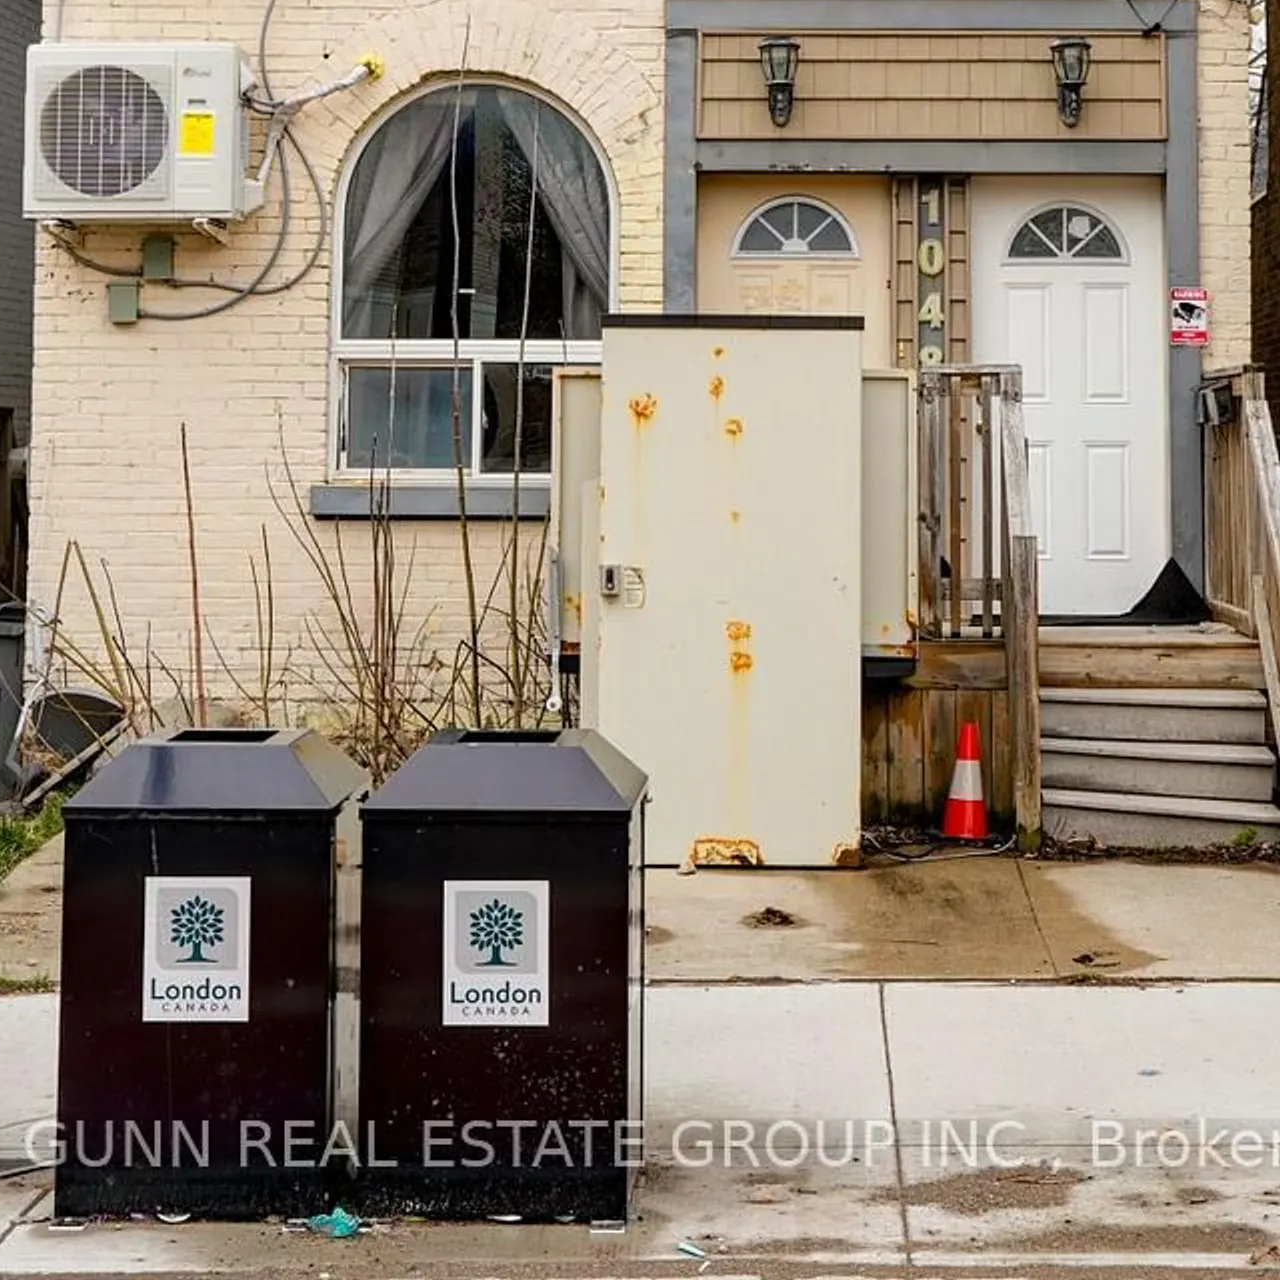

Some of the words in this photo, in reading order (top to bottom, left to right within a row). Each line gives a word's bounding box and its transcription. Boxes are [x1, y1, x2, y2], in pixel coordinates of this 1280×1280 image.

[150, 977, 241, 1000] London
[450, 980, 541, 1003] London
[162, 1003, 231, 1012] CANADA
[462, 1006, 531, 1016] CANADA
